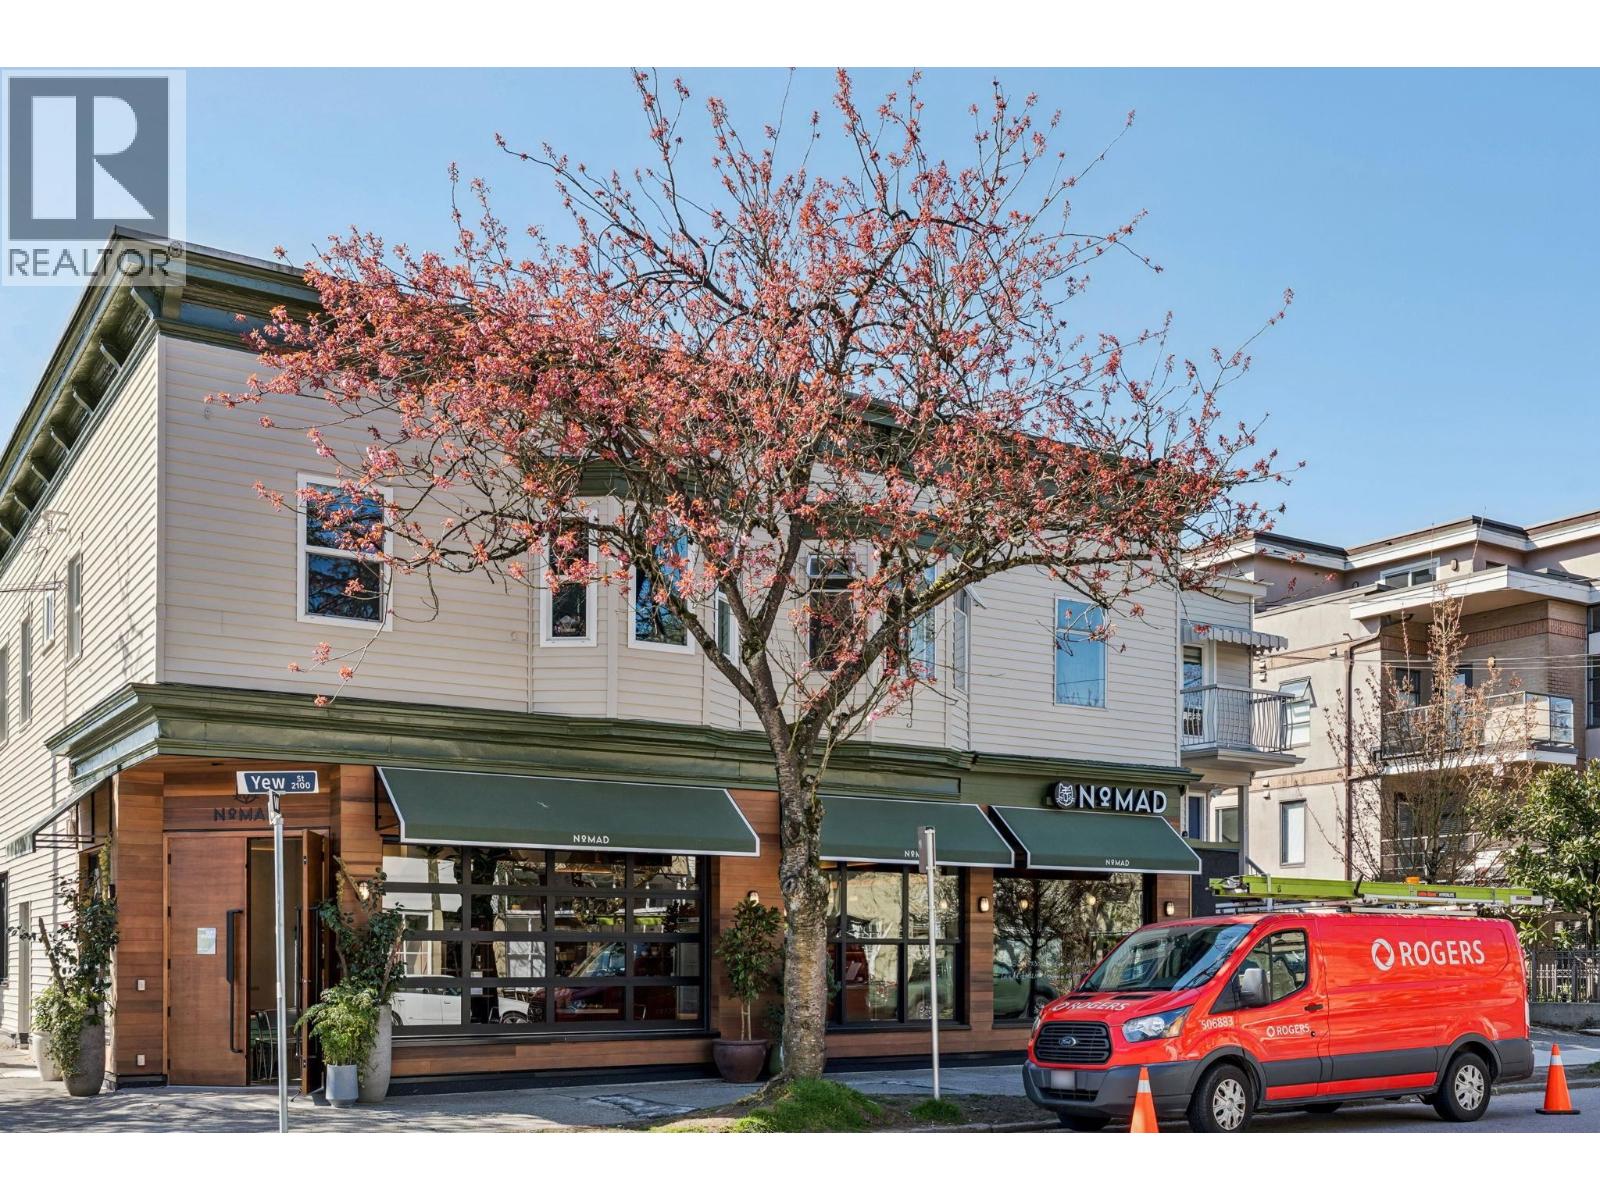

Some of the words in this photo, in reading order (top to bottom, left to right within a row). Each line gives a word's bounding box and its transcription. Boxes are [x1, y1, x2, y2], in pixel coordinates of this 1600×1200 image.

[251, 775, 285, 790] Yew
[291, 782, 311, 790] 2100
[214, 808, 265, 821] NOMA
[1398, 939, 1486, 967] ROGERS
[1276, 1024, 1310, 1036] ROGERS
